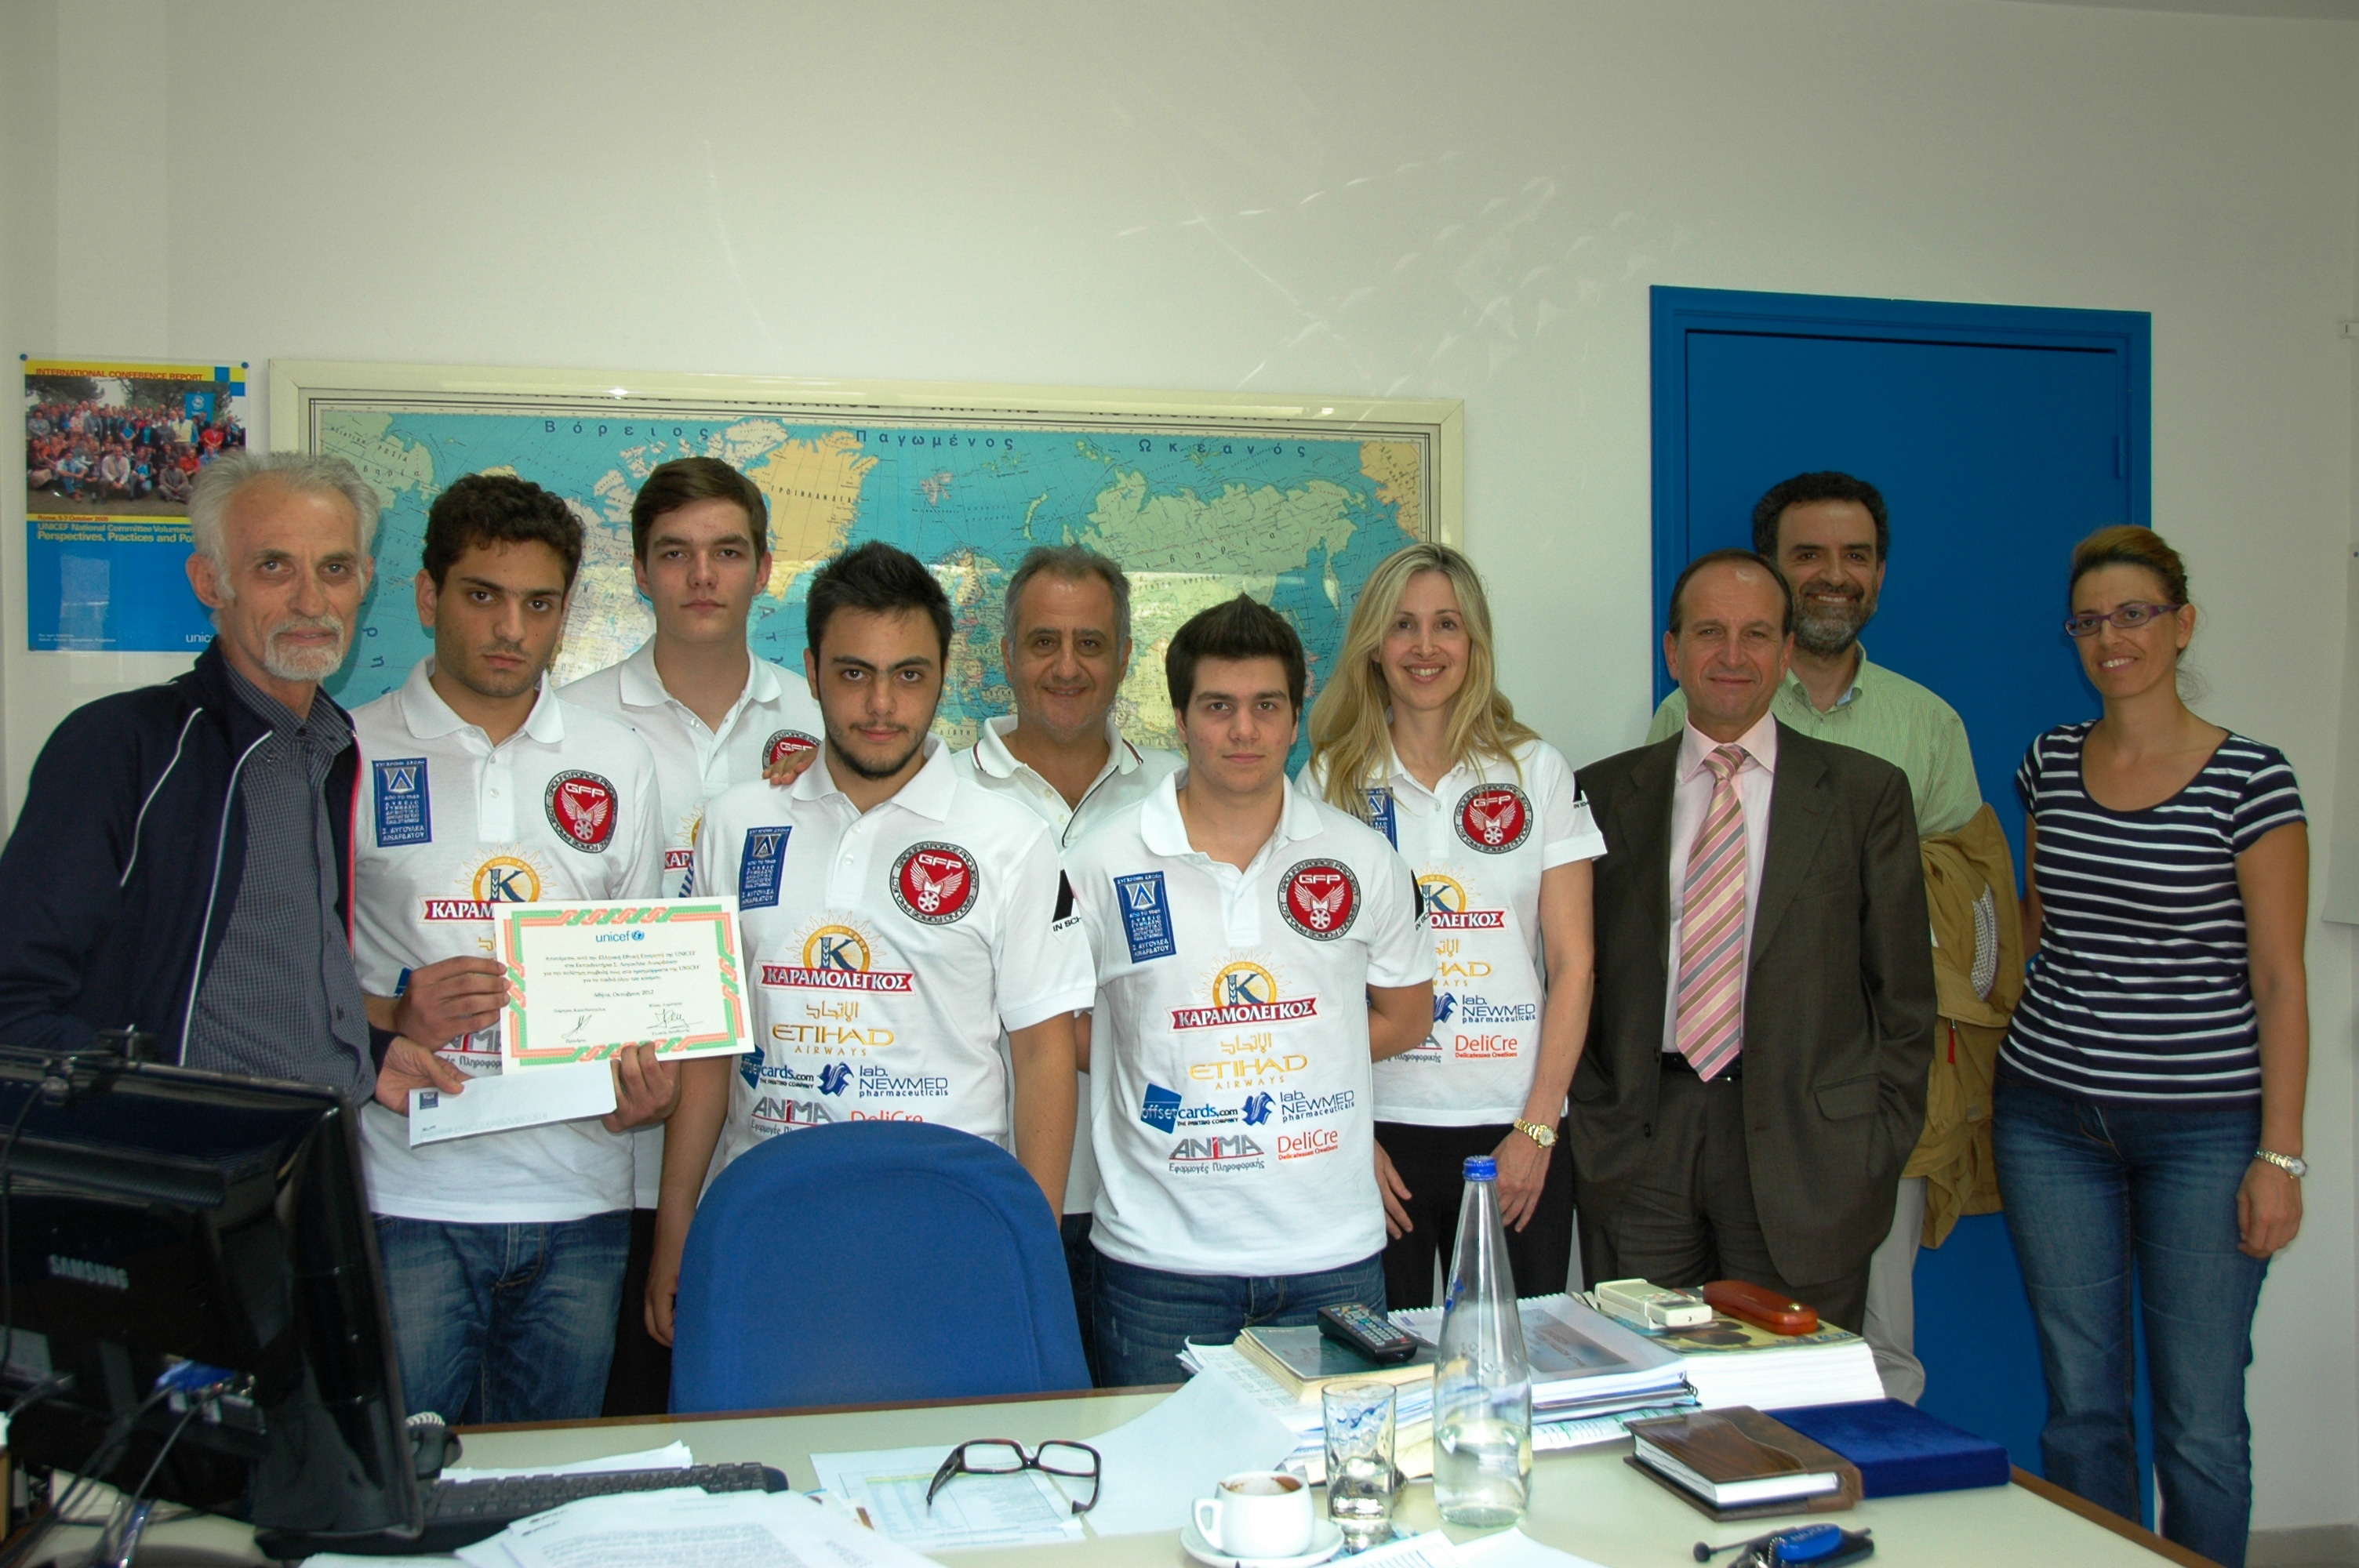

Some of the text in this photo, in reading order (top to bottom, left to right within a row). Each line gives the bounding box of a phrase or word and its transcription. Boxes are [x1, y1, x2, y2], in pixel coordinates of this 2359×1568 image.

[36, 368, 203, 381] INTERNATIONAL CONFERENCE REPORT
[545, 420, 708, 441] Βόρειος
[856, 430, 1014, 451] Παγωμένος
[1139, 438, 1306, 458] Ωκεανός
[37, 531, 176, 543] Perspectives, Practices and
[185, 632, 213, 644] unic
[565, 782, 605, 798] GFP
[1474, 795, 1511, 807] GFP
[918, 853, 962, 870] GFP
[1299, 874, 1341, 884] GFP
[1052, 923, 1063, 931] IN
[1430, 913, 1500, 927] ΟΛΕΓΚΟΣ
[595, 931, 631, 942] unicef
[767, 967, 907, 990] ΚΑΡΑΜΟΛΕΓΚΟΣ
[1463, 994, 1487, 1005] lab.
[1178, 1000, 1314, 1027] ΚΑΡΑΜΟΛΕΓΚΟΣ
[1463, 1004, 1536, 1017] NEWMED
[1462, 1014, 1536, 1024] pharmaceuticals
[772, 1023, 895, 1047] ETIHAD
[794, 1044, 867, 1057] AIRWAYS
[1456, 1034, 1518, 1052] DeliCre
[860, 1065, 888, 1077] lab.
[1189, 1053, 1308, 1080] ETIHAD
[860, 1077, 948, 1091] NEWMED
[1216, 1075, 1285, 1091] AIRWAYS
[860, 1087, 948, 1098] pharmaceuticals
[1280, 1089, 1306, 1103] lab.
[1282, 1090, 1354, 1115] NEWMED
[1140, 1103, 1238, 1120] offsetcards.com
[1282, 1101, 1355, 1123] pharmaceuticals
[1278, 1128, 1338, 1153] DeliCre
[49, 1254, 129, 1290] SAMSUNG
